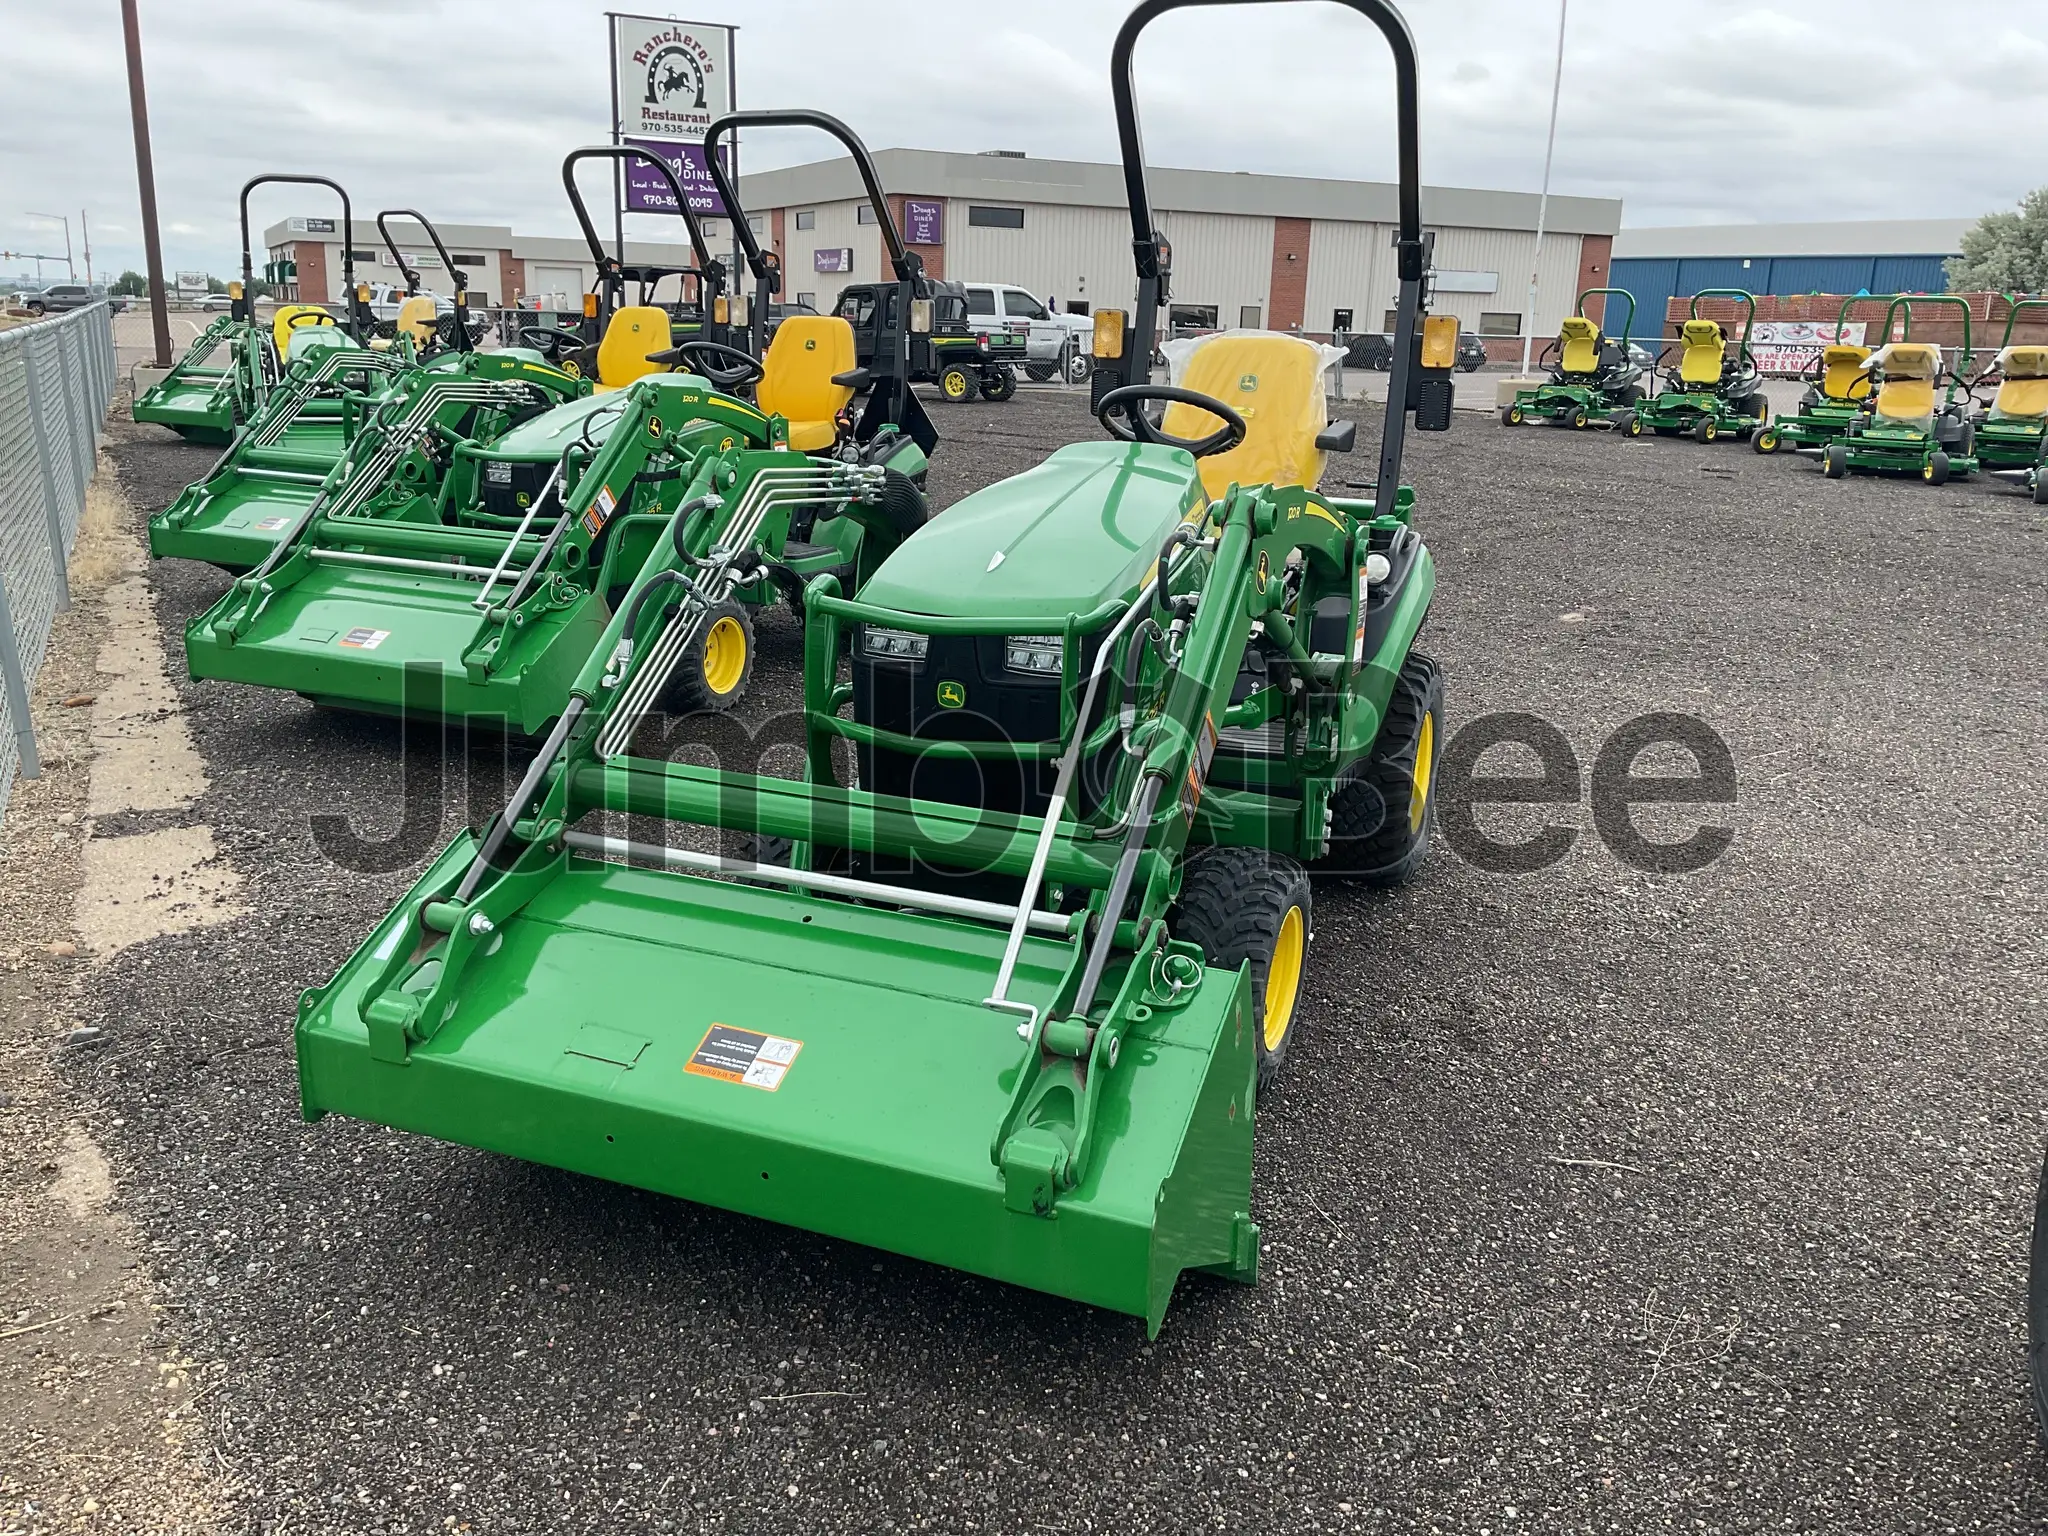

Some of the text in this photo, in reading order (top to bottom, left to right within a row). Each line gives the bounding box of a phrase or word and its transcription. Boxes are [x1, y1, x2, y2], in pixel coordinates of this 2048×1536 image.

[633, 26, 714, 74] Ranchero's
[641, 106, 711, 124] Restaurant
[641, 122, 709, 135] 970-535-445
[683, 169, 714, 181] DINE
[643, 194, 713, 208] 970-800095
[1775, 344, 1824, 353] 970-535
[1753, 360, 1776, 370] EER
[1779, 360, 1787, 370] &
